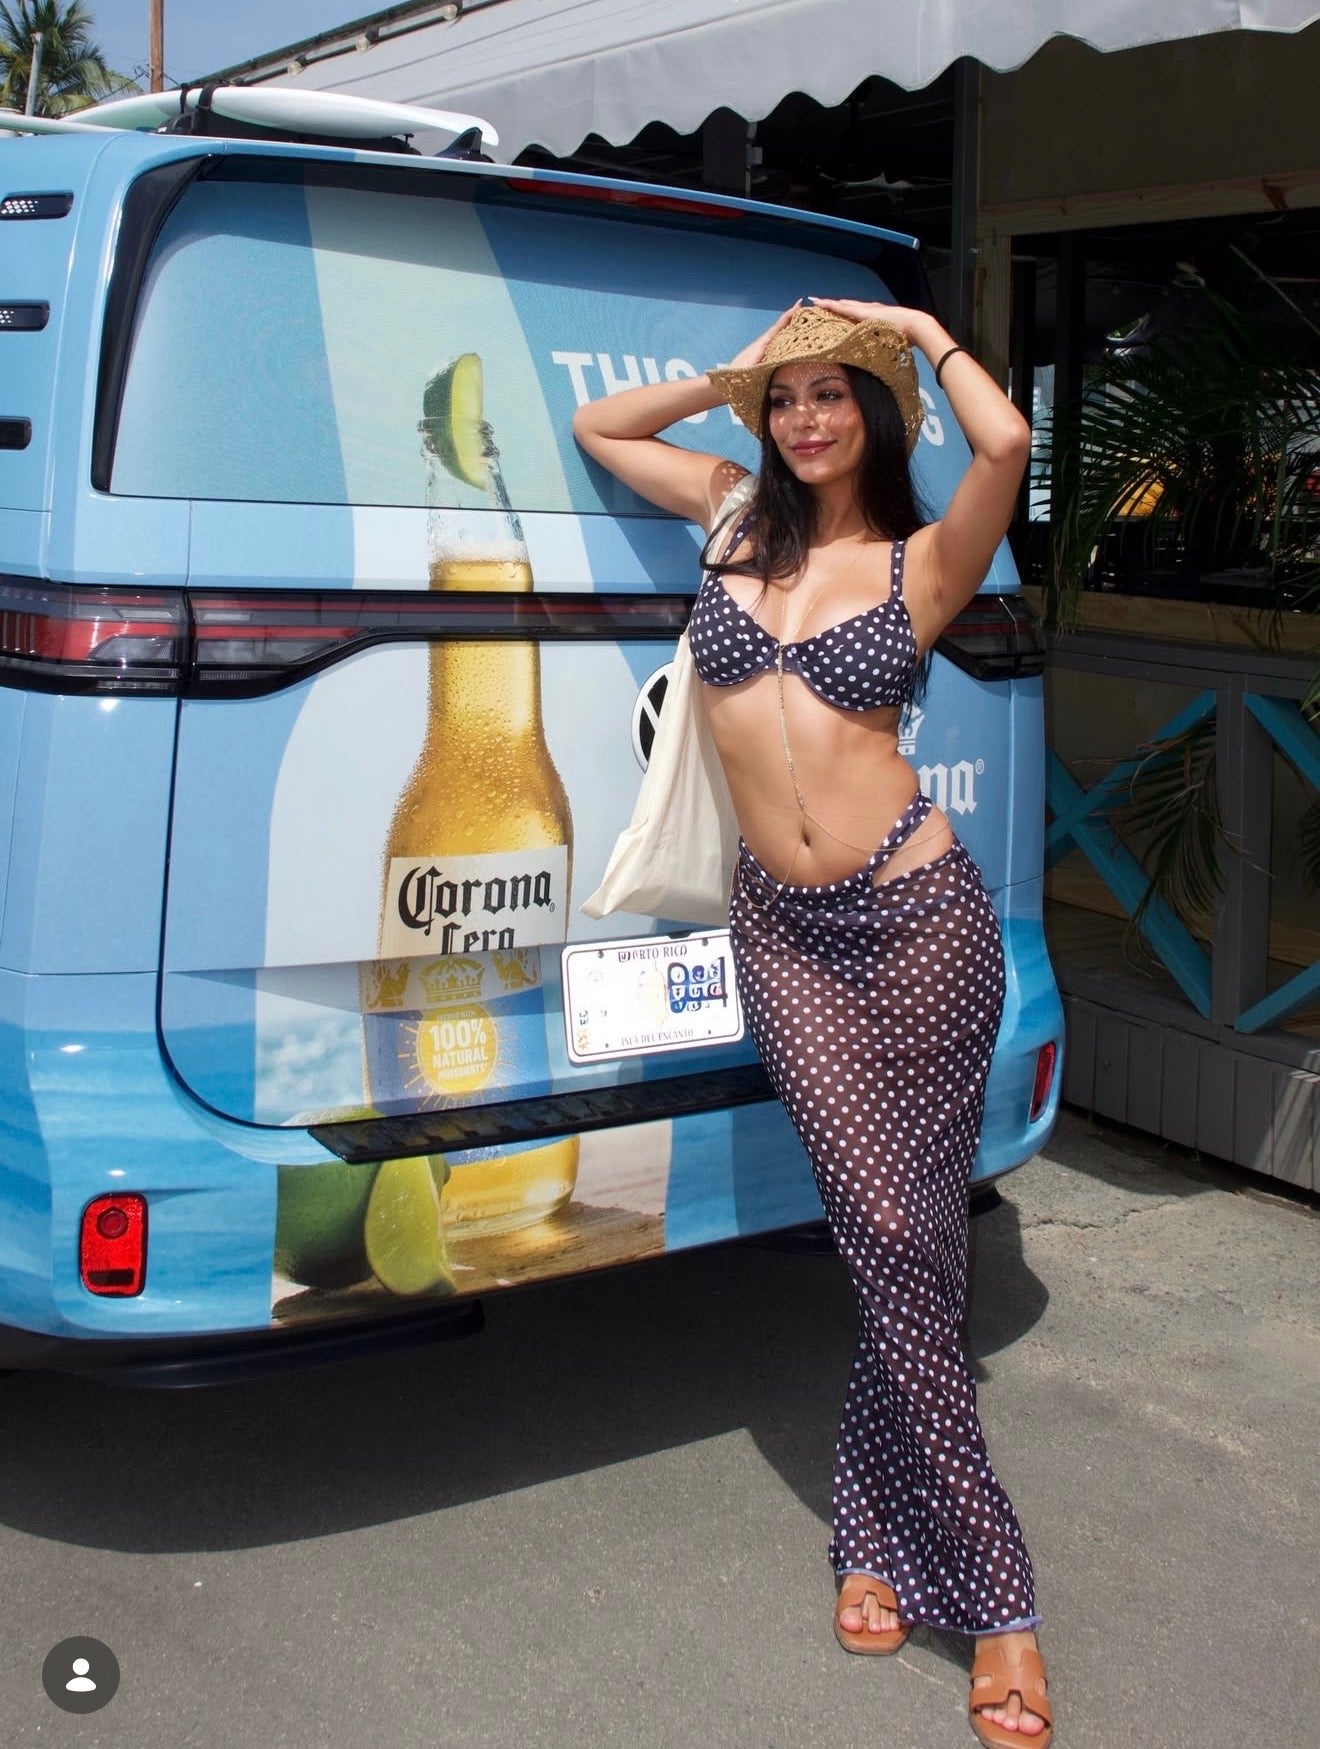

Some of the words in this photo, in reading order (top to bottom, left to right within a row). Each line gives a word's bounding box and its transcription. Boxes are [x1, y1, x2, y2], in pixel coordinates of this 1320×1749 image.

[398, 865, 552, 936] Corona
[430, 1018, 487, 1052] 100%
[432, 1047, 488, 1069] NATURAL
